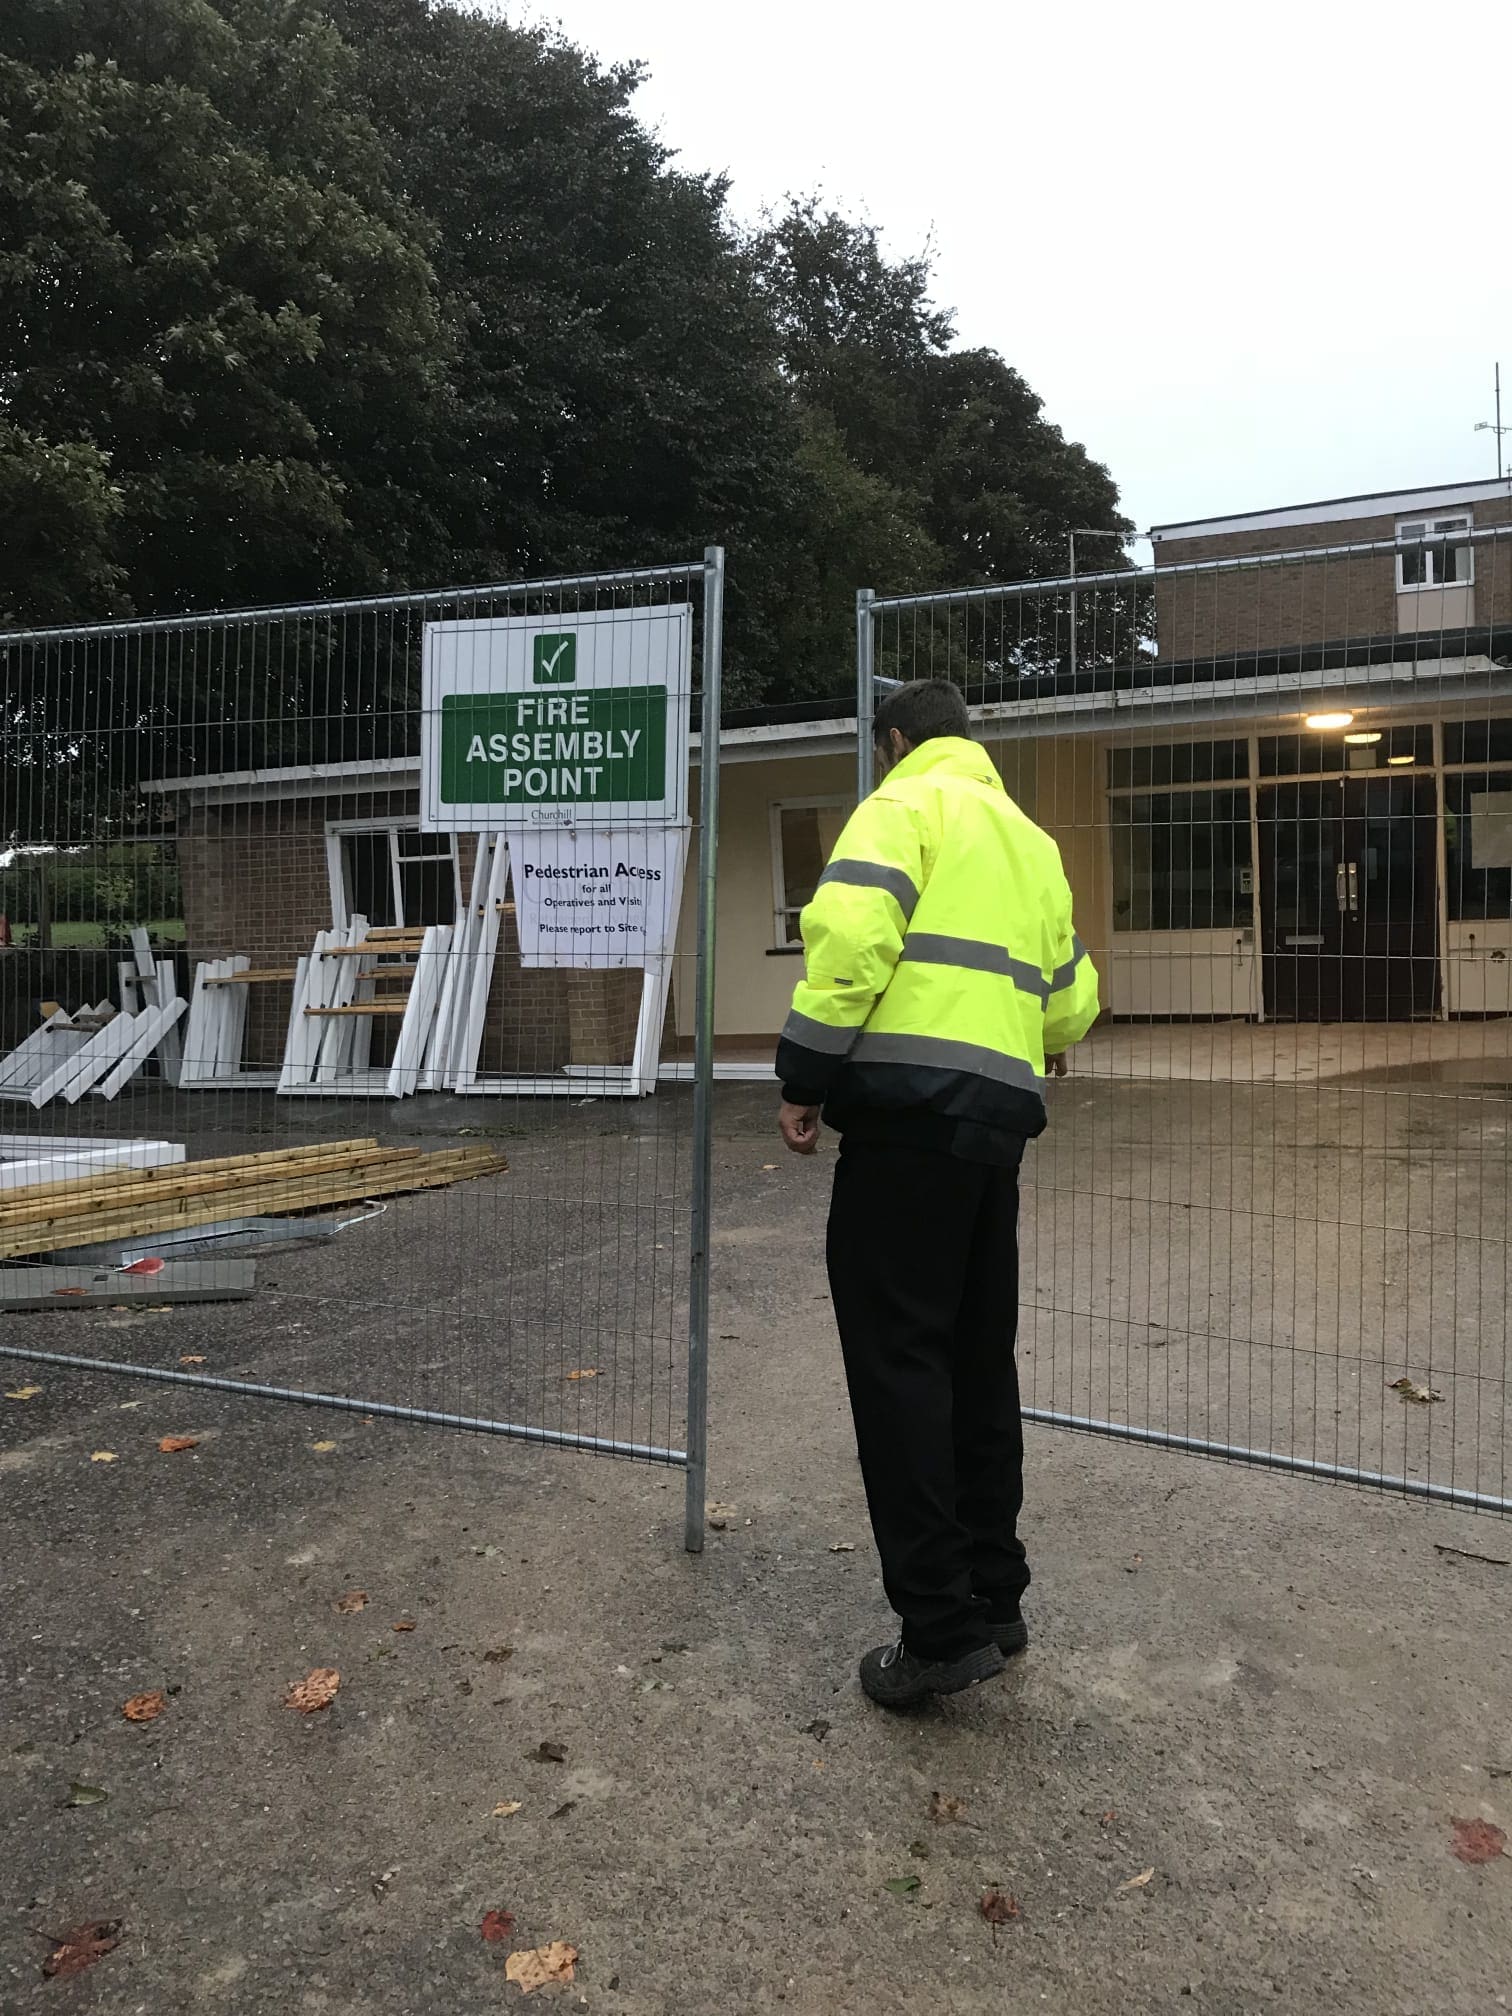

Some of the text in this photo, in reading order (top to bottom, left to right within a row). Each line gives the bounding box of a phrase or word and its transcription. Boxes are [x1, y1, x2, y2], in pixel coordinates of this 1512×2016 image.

[517, 696, 589, 726] FIRE
[466, 729, 641, 762] ASSEMBLY
[503, 766, 603, 796] POINT
[531, 808, 572, 820] Churchill
[524, 862, 662, 881] Pedestrian Acess
[582, 884, 611, 893] for all
[544, 897, 595, 909] Operatives
[598, 897, 616, 905] and
[540, 924, 568, 933] Please
[570, 924, 601, 936] report
[605, 923, 615, 933] to
[618, 923, 638, 932] Site
